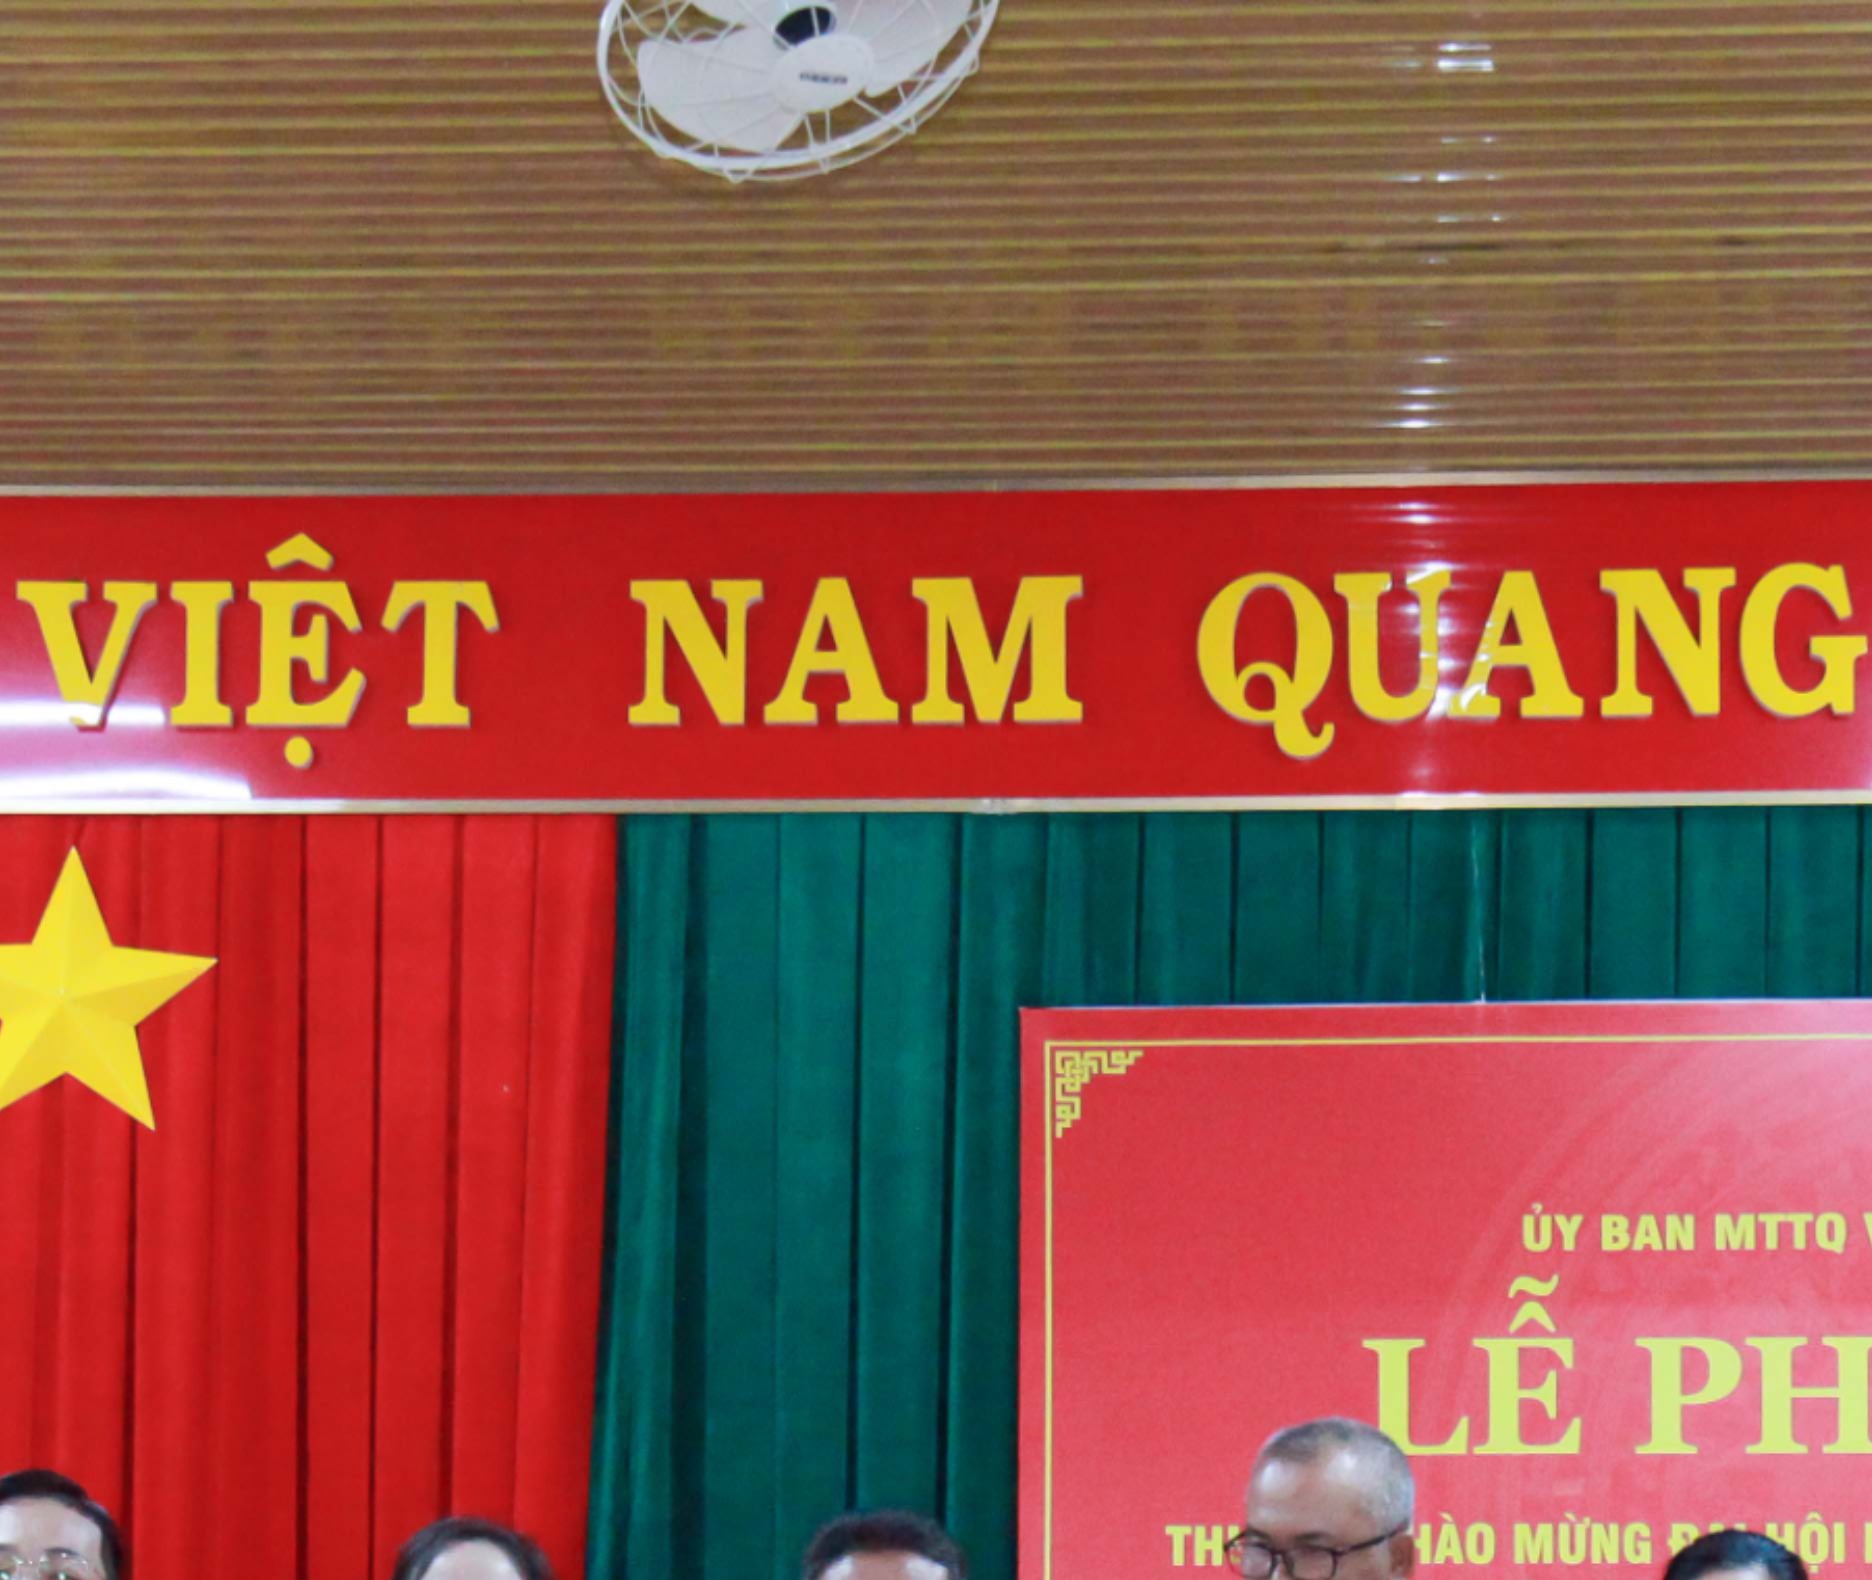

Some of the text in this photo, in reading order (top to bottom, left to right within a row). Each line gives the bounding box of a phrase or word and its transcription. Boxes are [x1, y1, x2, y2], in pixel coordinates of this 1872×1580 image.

[16, 533, 499, 767] VIỆT
[628, 575, 1084, 725] NAM
[1196, 562, 1870, 758] QUANG
[1522, 1202, 1584, 1252] ỦY
[1602, 1213, 1696, 1251] BAN
[1714, 1212, 1848, 1253] MTTQ
[1362, 1275, 1582, 1456] LỄ
[1413, 1511, 1497, 1565] HÀO
[1513, 1511, 1654, 1564] MỪNG
